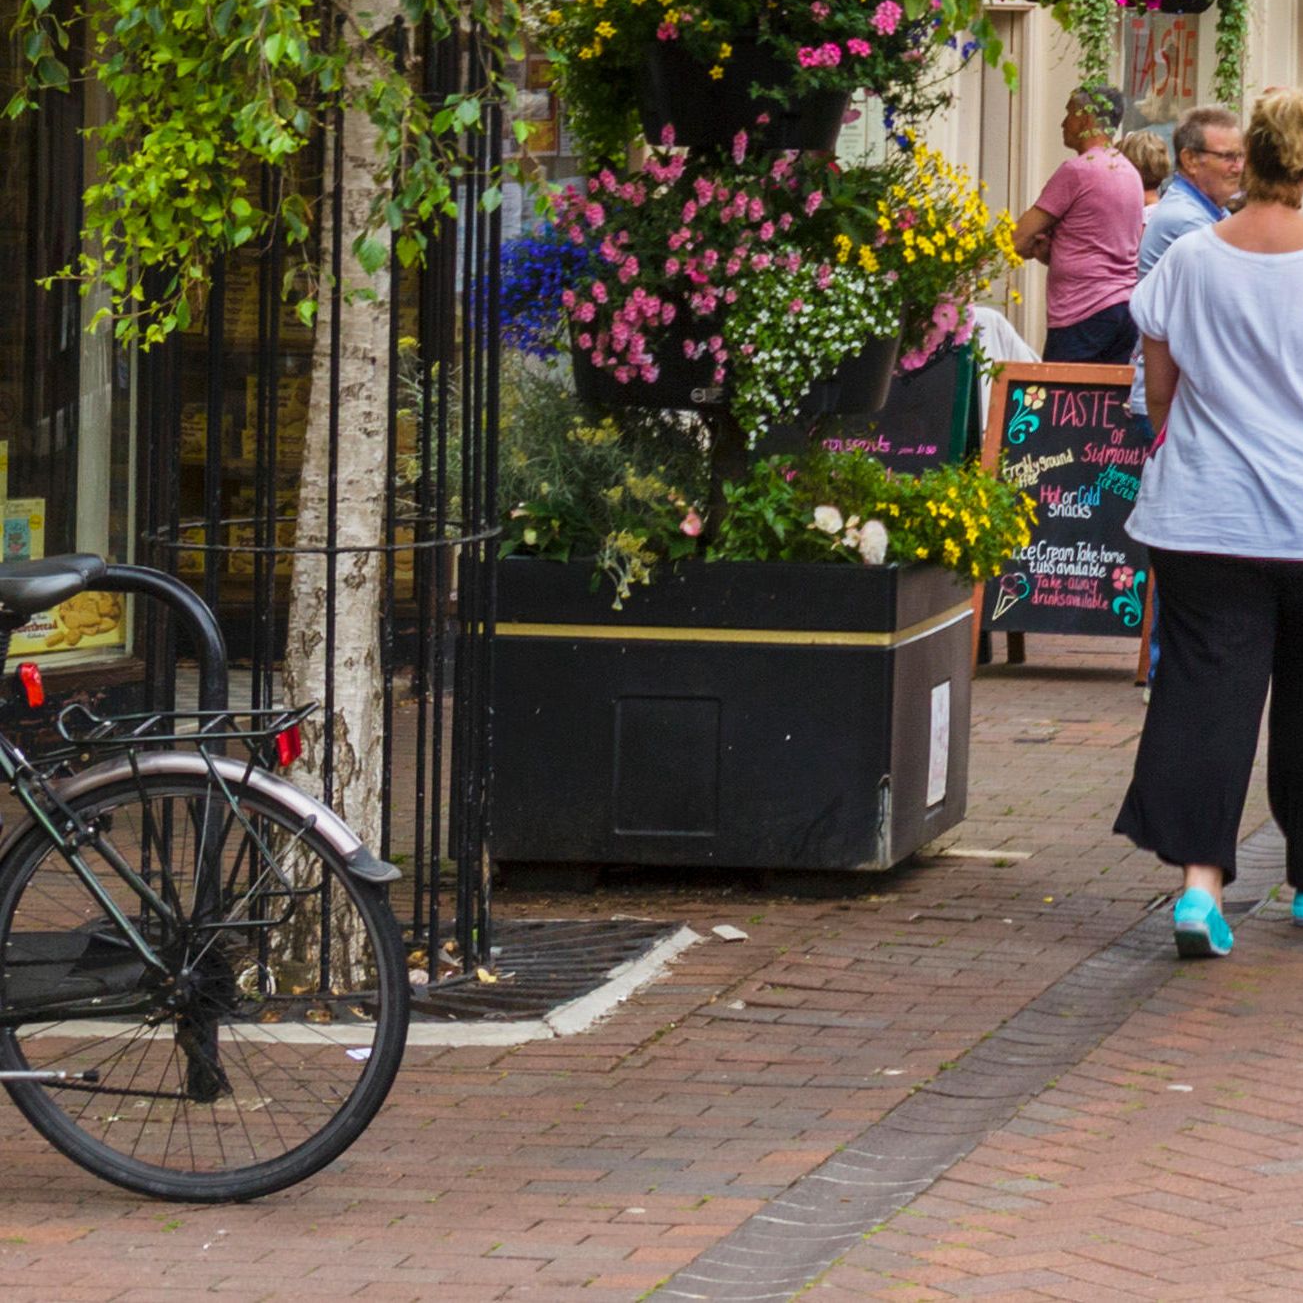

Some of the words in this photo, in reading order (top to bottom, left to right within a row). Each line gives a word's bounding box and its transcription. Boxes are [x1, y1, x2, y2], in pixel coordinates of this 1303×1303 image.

[1131, 18, 1197, 98] TASTE
[1050, 388, 1121, 429] TASTE
[1039, 483, 1062, 504] Hot
[1061, 491, 1078, 505] or
[1076, 485, 1101, 507] Cold
[1036, 540, 1075, 562] Cream
[1056, 561, 1107, 578] available
[1031, 589, 1065, 607] drinks
[1065, 593, 1109, 611] available
